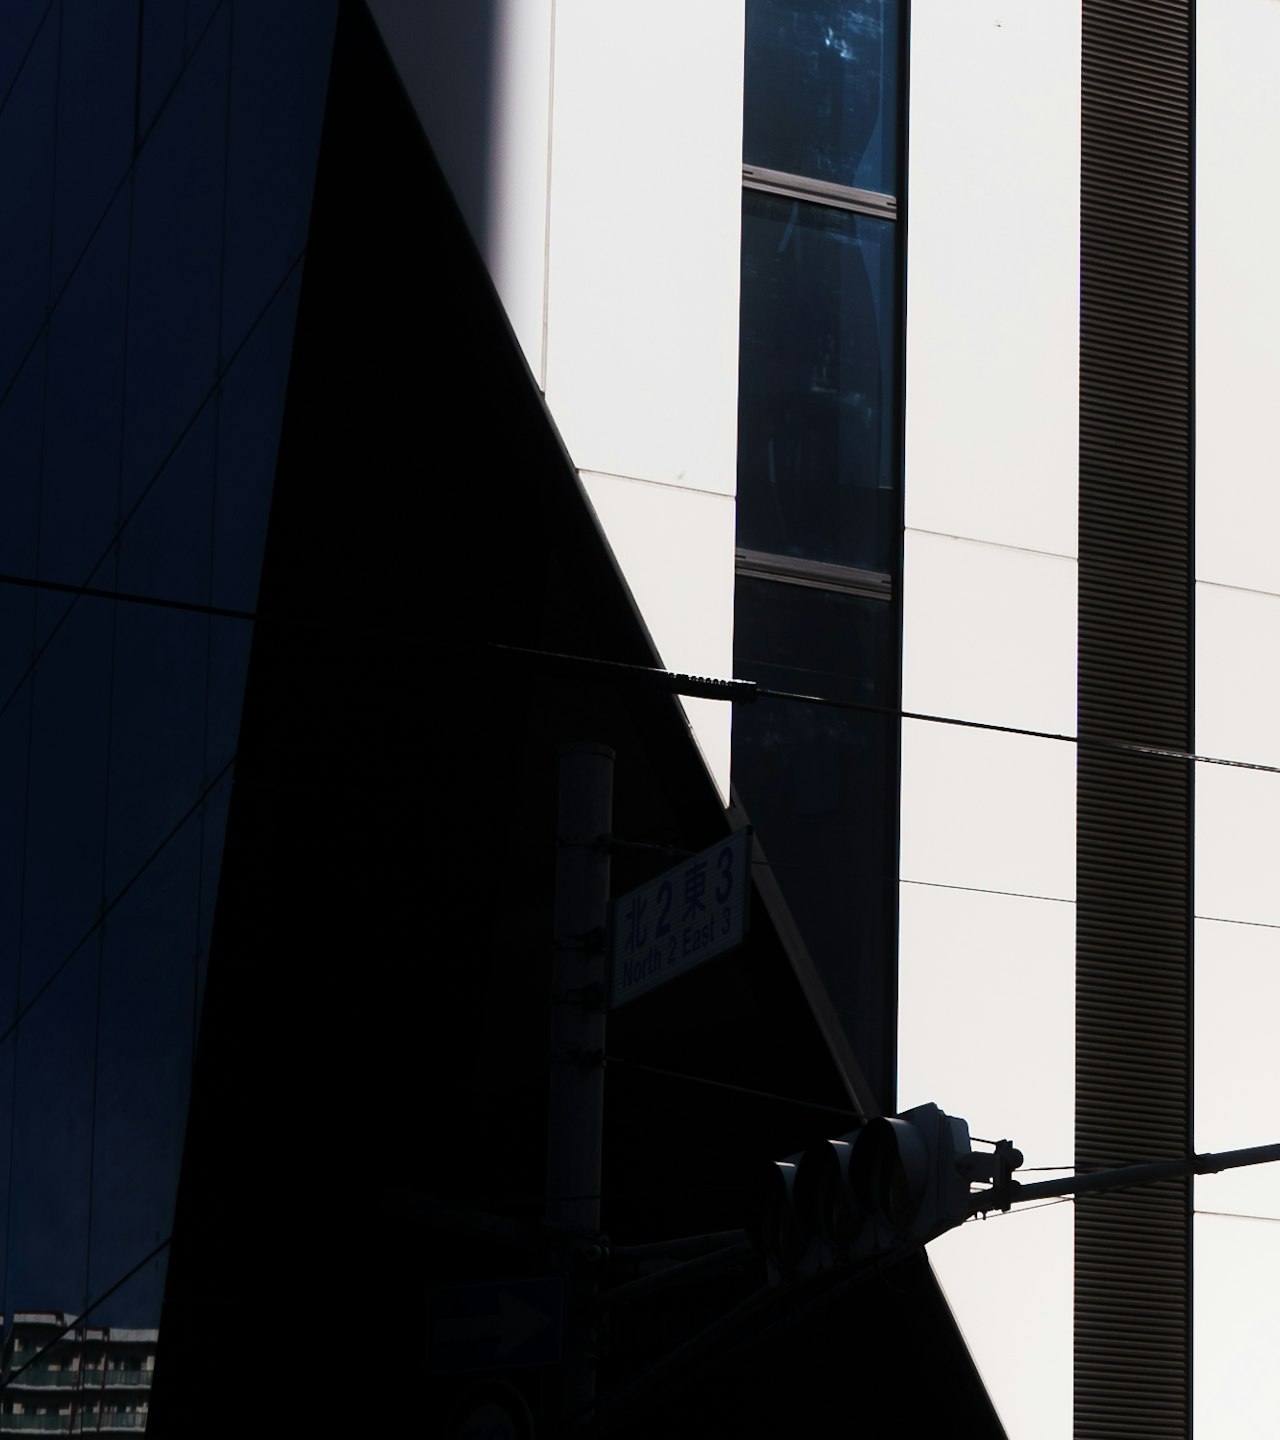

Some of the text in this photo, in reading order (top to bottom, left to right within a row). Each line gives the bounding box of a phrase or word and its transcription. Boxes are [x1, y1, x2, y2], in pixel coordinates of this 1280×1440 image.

[624, 846, 733, 953] 北2東3
[623, 907, 731, 987] North 2 East 3
